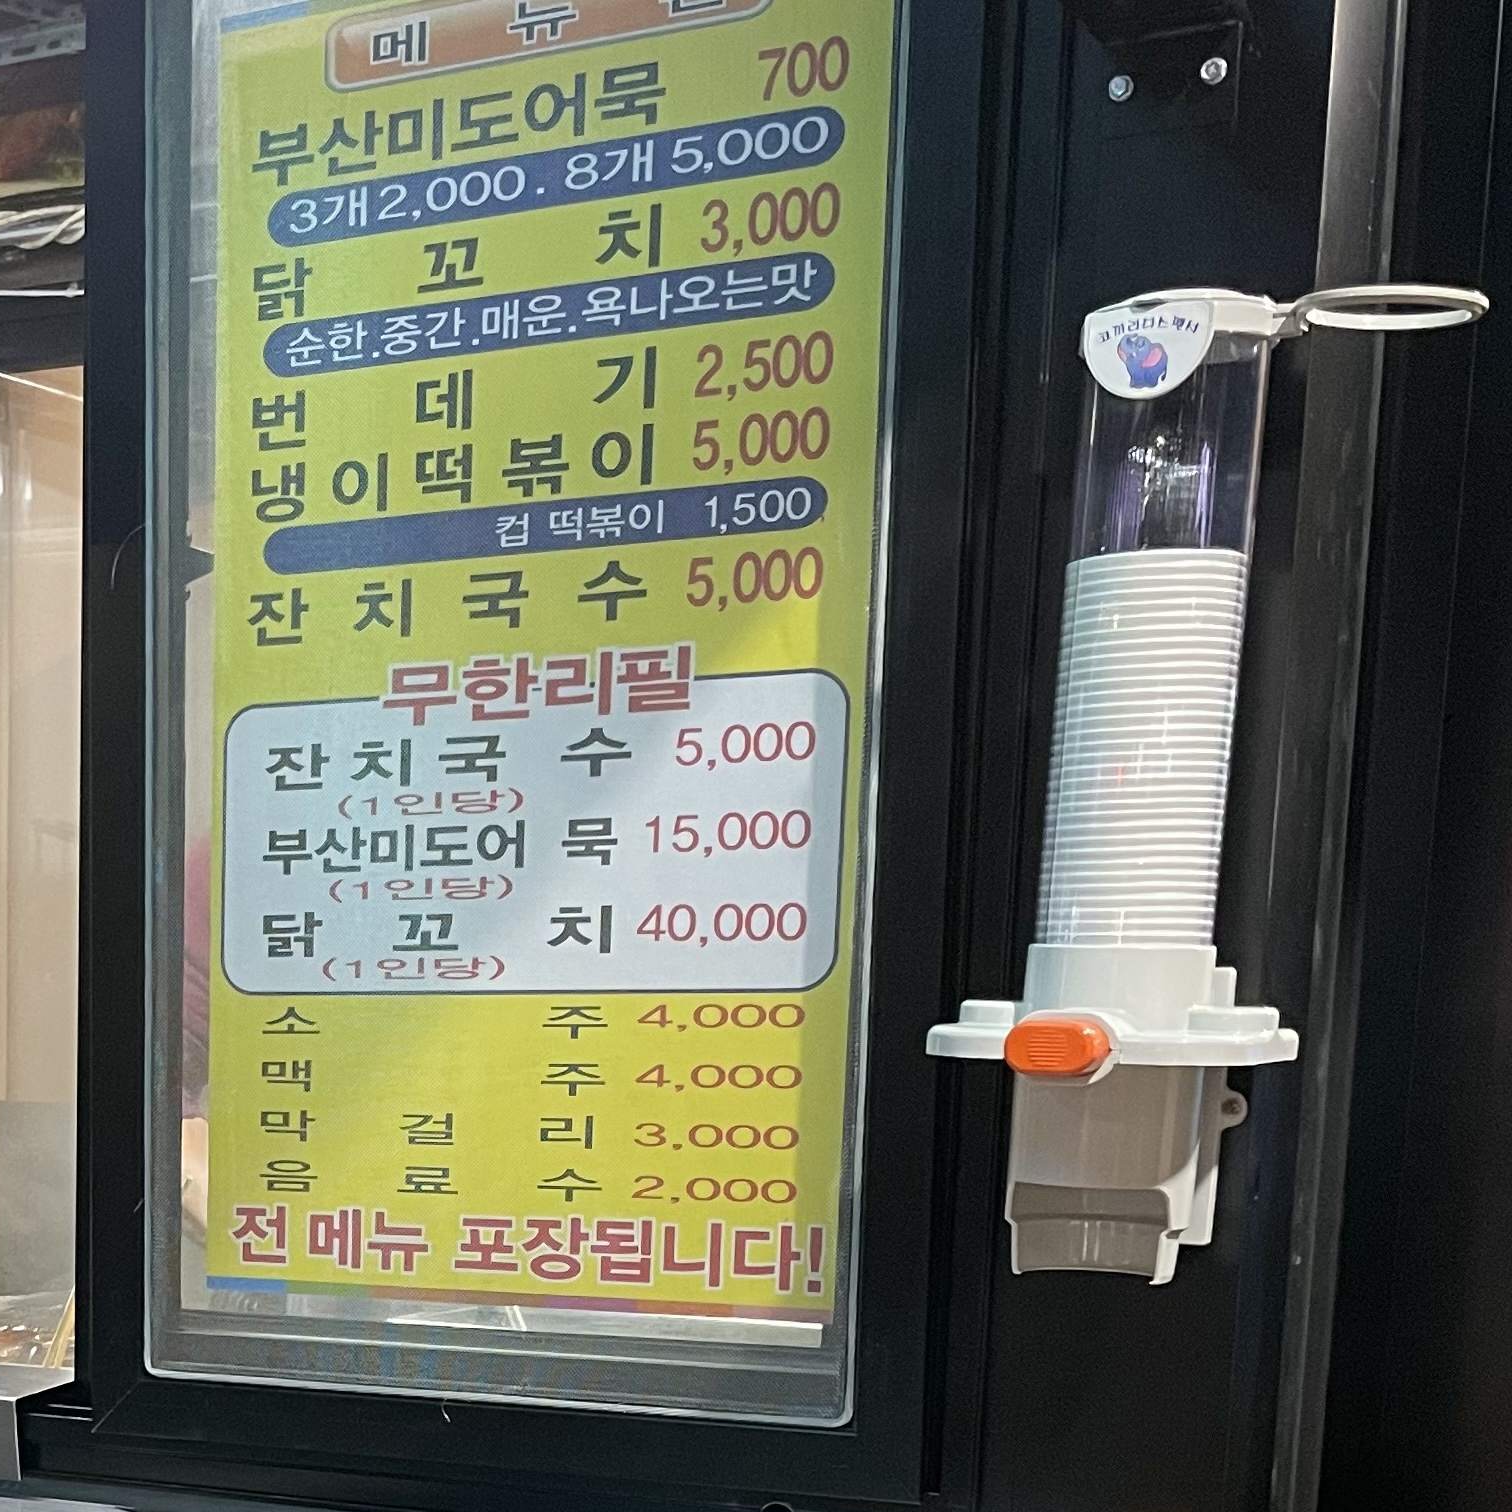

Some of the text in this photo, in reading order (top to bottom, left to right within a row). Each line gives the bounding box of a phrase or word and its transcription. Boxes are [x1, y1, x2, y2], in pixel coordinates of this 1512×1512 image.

[252, 36, 850, 186] 부산미도어묵 700
[565, 140, 653, 191] 8개
[670, 116, 829, 173] 5,000
[699, 182, 842, 257] 3,000
[694, 331, 834, 402] 2,500
[691, 406, 831, 475] 5,000
[496, 486, 813, 547] 컵 떡볶이 1,500
[686, 546, 825, 612] 5,000
[384, 648, 691, 725] 무한리필
[674, 721, 817, 772] 5,000
[337, 788, 526, 821] (1인당)
[646, 809, 812, 859] 15,000
[328, 875, 514, 903] (1인당)
[636, 902, 808, 948] 40,000
[321, 955, 506, 981] (1인당)
[636, 1003, 807, 1033] 4,000
[633, 1064, 804, 1095] 4,000
[633, 1123, 801, 1154] 3,000
[631, 1175, 799, 1206] 2,000
[455, 1219, 824, 1294] 포장됩니다!
